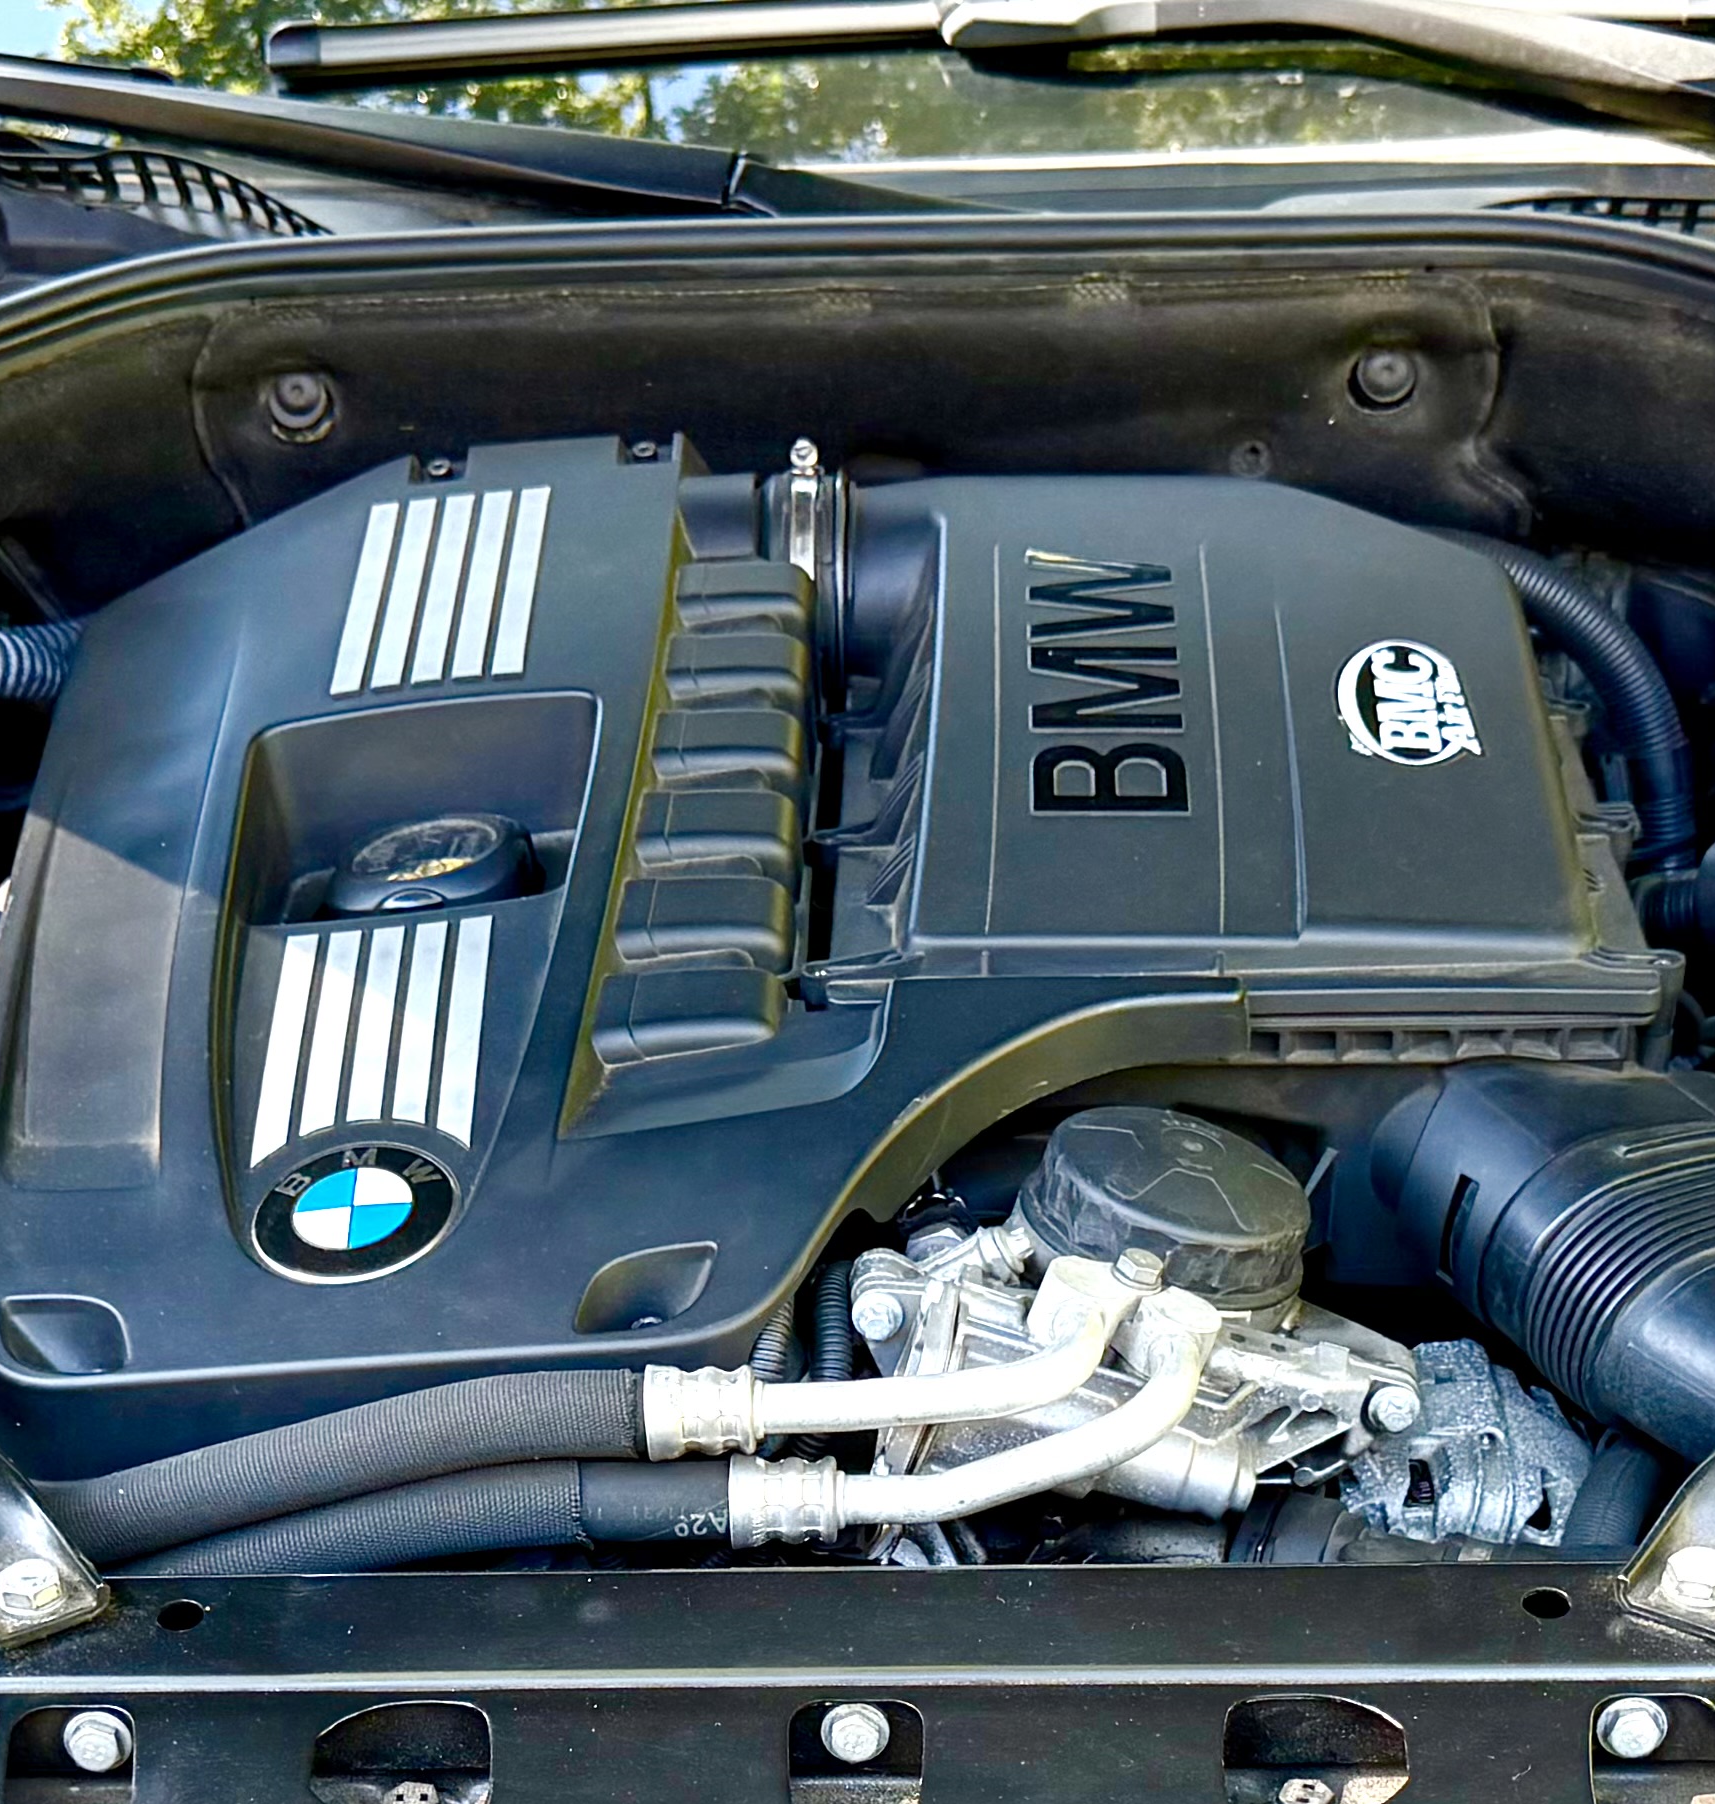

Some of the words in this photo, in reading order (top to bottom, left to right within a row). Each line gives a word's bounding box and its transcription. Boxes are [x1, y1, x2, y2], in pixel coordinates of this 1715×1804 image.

[1025, 547, 1190, 816] BMW
[1371, 650, 1442, 754] BMC
[274, 1147, 443, 1197] BMW
